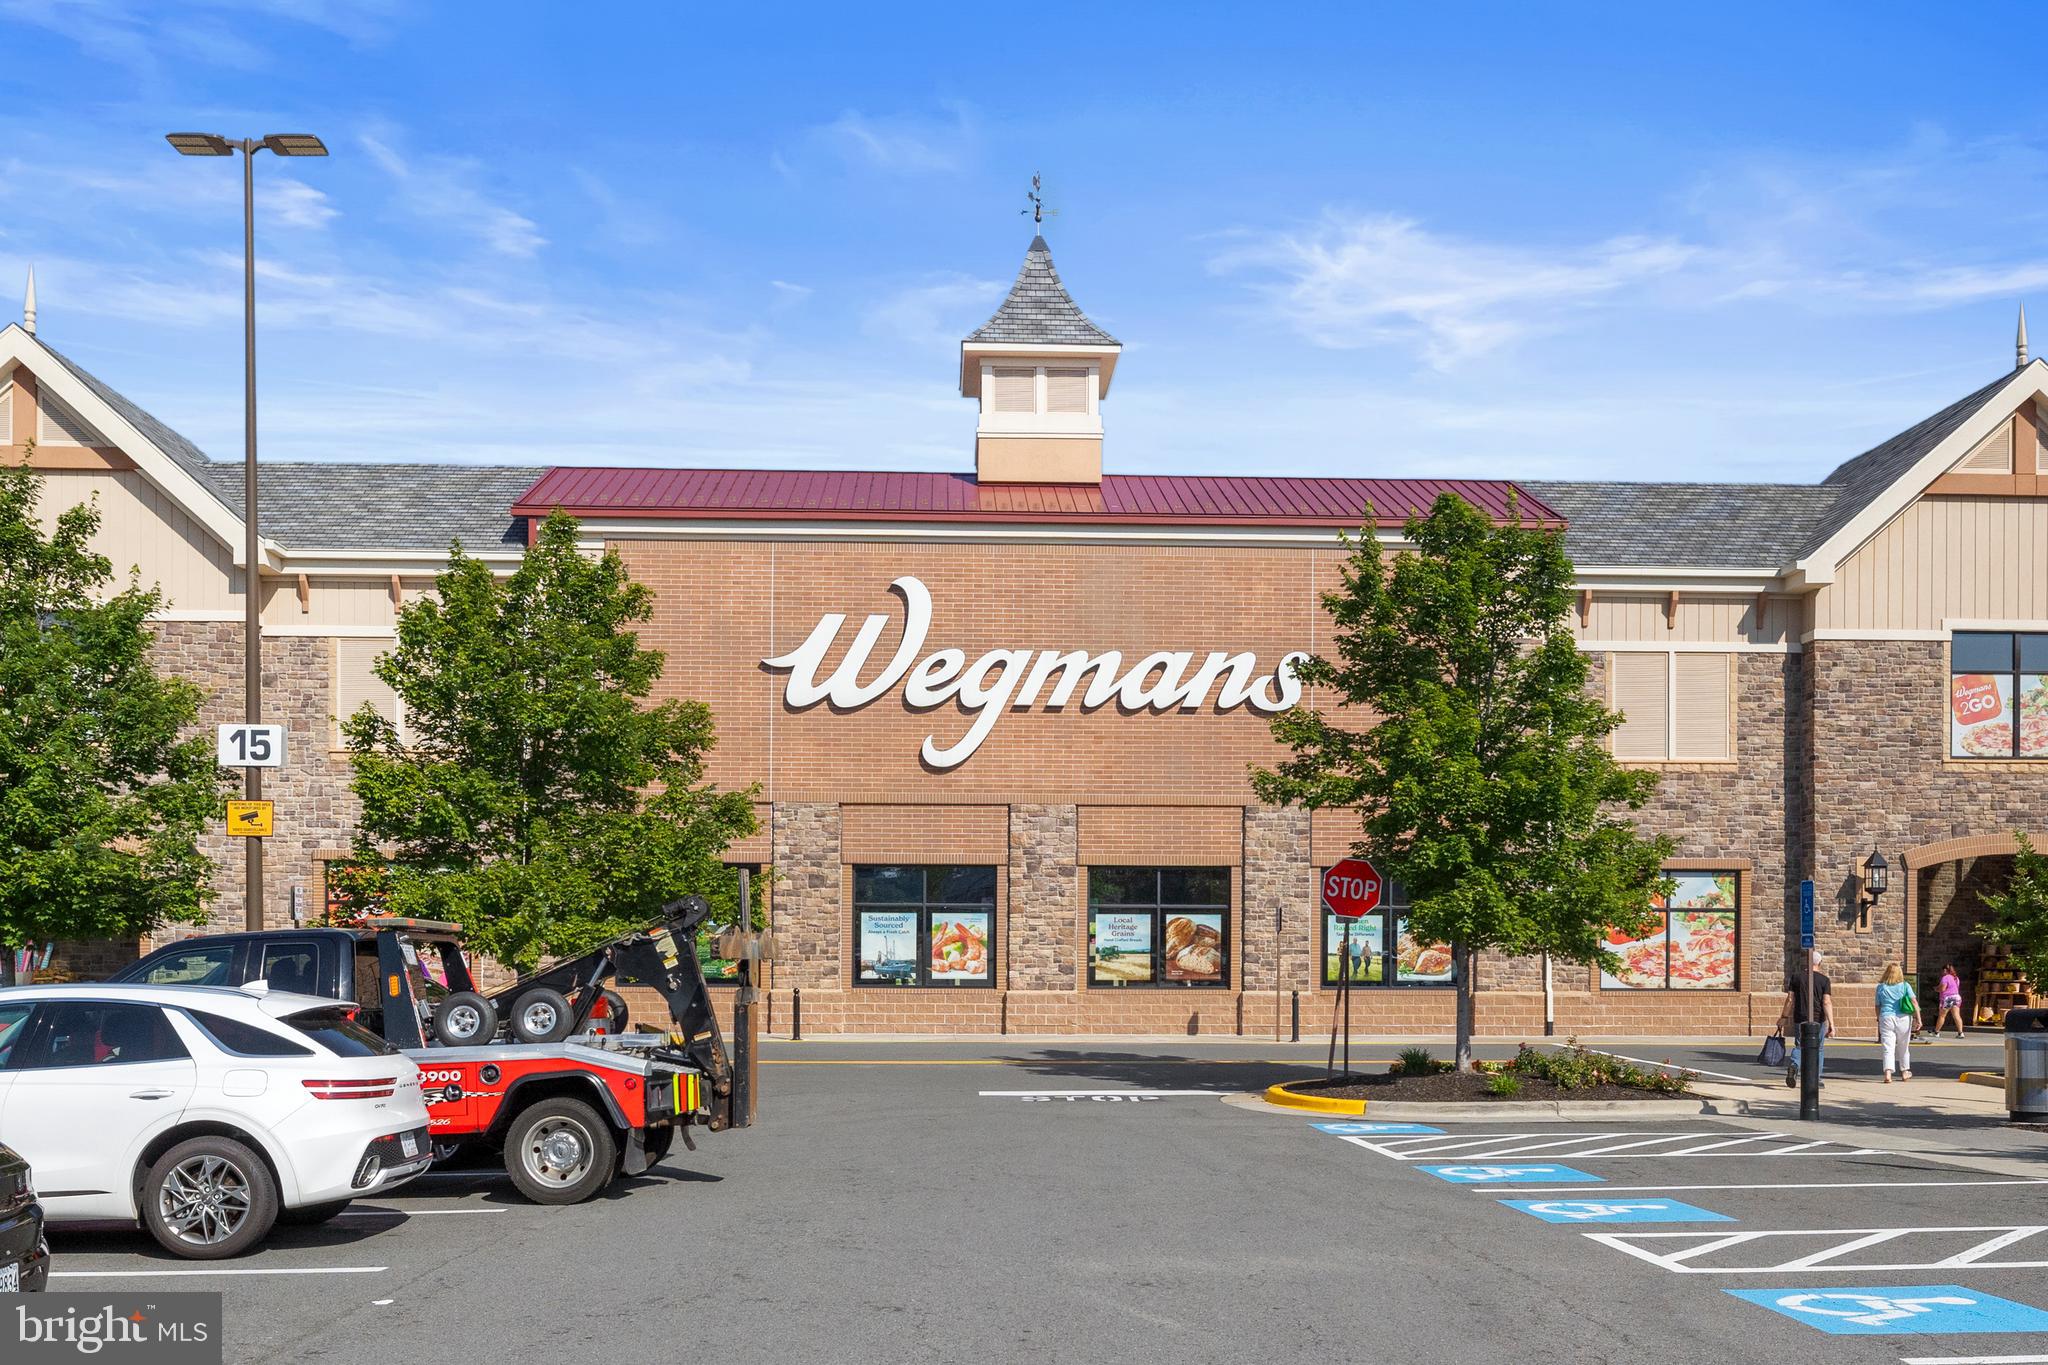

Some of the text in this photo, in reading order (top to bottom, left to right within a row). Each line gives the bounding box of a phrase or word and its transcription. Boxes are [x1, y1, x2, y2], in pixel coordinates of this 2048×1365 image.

[761, 576, 1310, 768] Wegmans
[1955, 683, 1992, 699] Wegmans
[1960, 694, 1995, 715] 2GO
[229, 729, 271, 761] 15
[1327, 875, 1378, 900] STOP
[868, 915, 910, 923] Sustainably
[1108, 923, 1138, 931] Heritage
